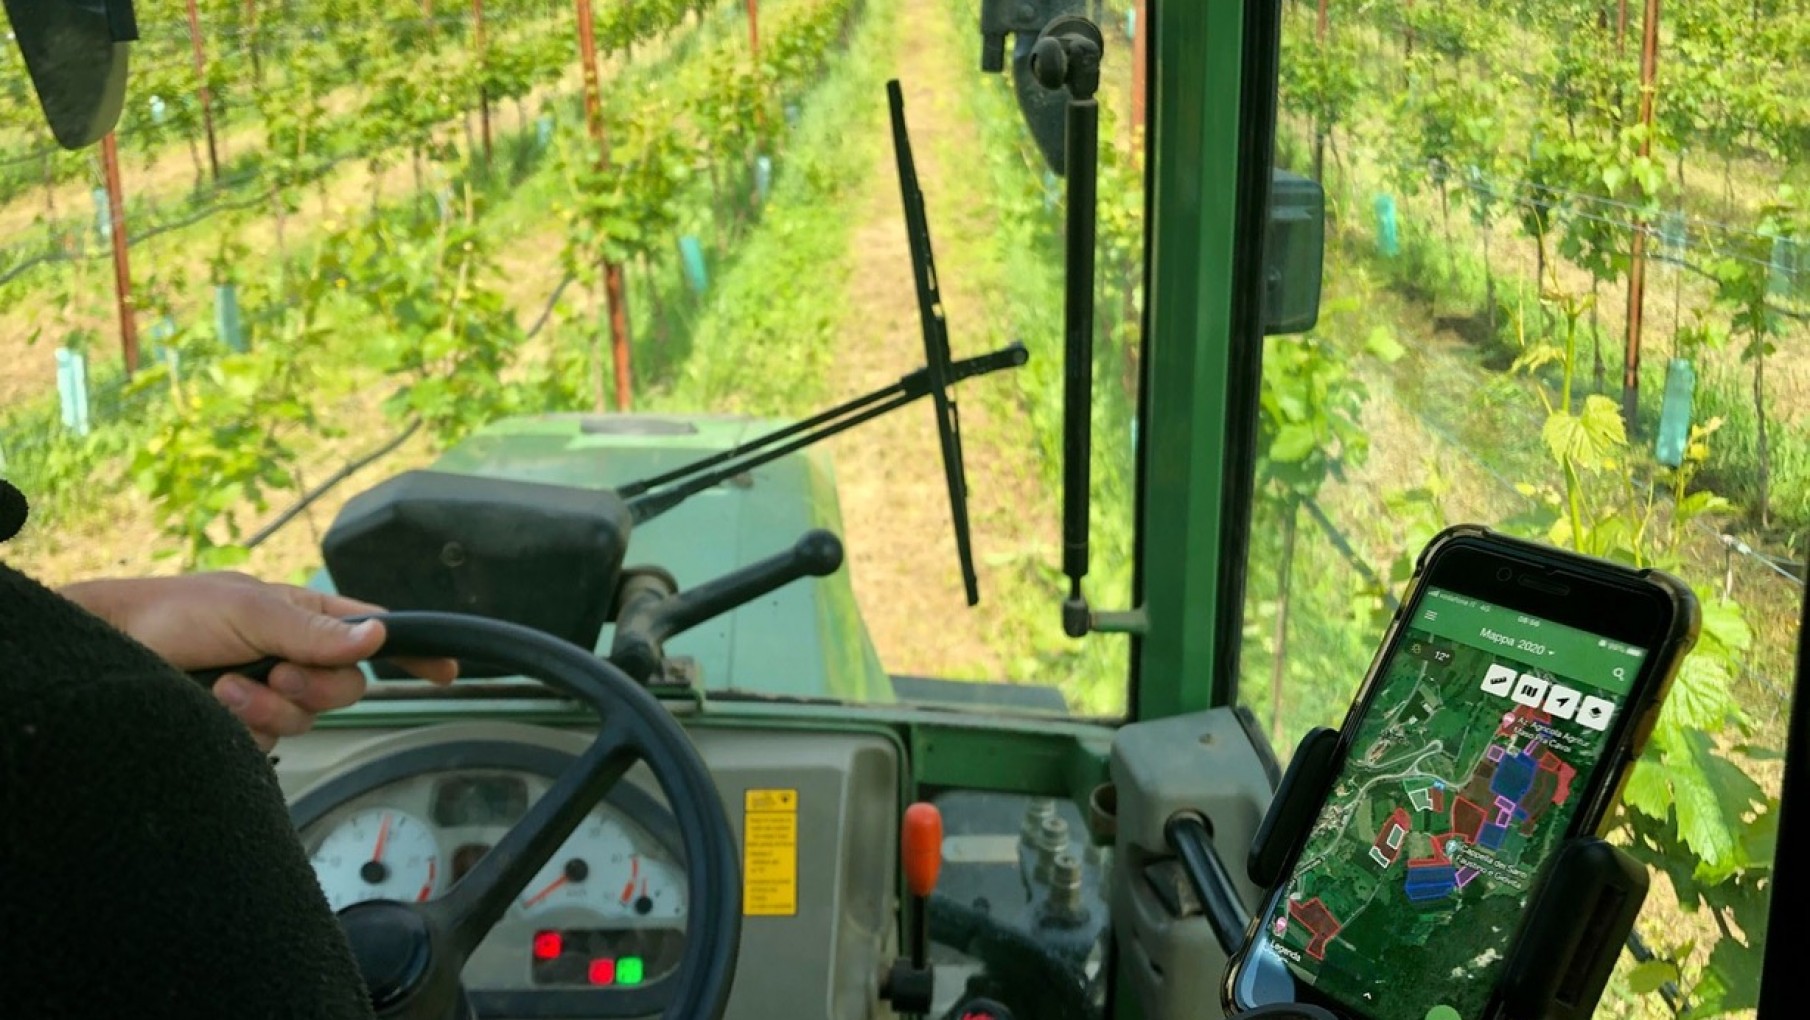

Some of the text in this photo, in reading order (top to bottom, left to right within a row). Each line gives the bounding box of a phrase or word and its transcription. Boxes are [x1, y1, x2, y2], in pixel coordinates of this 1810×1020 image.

[1480, 627, 1546, 656] Mappa 2020
[1530, 721, 1562, 738] Agricola
[1271, 939, 1301, 962] Legenda
